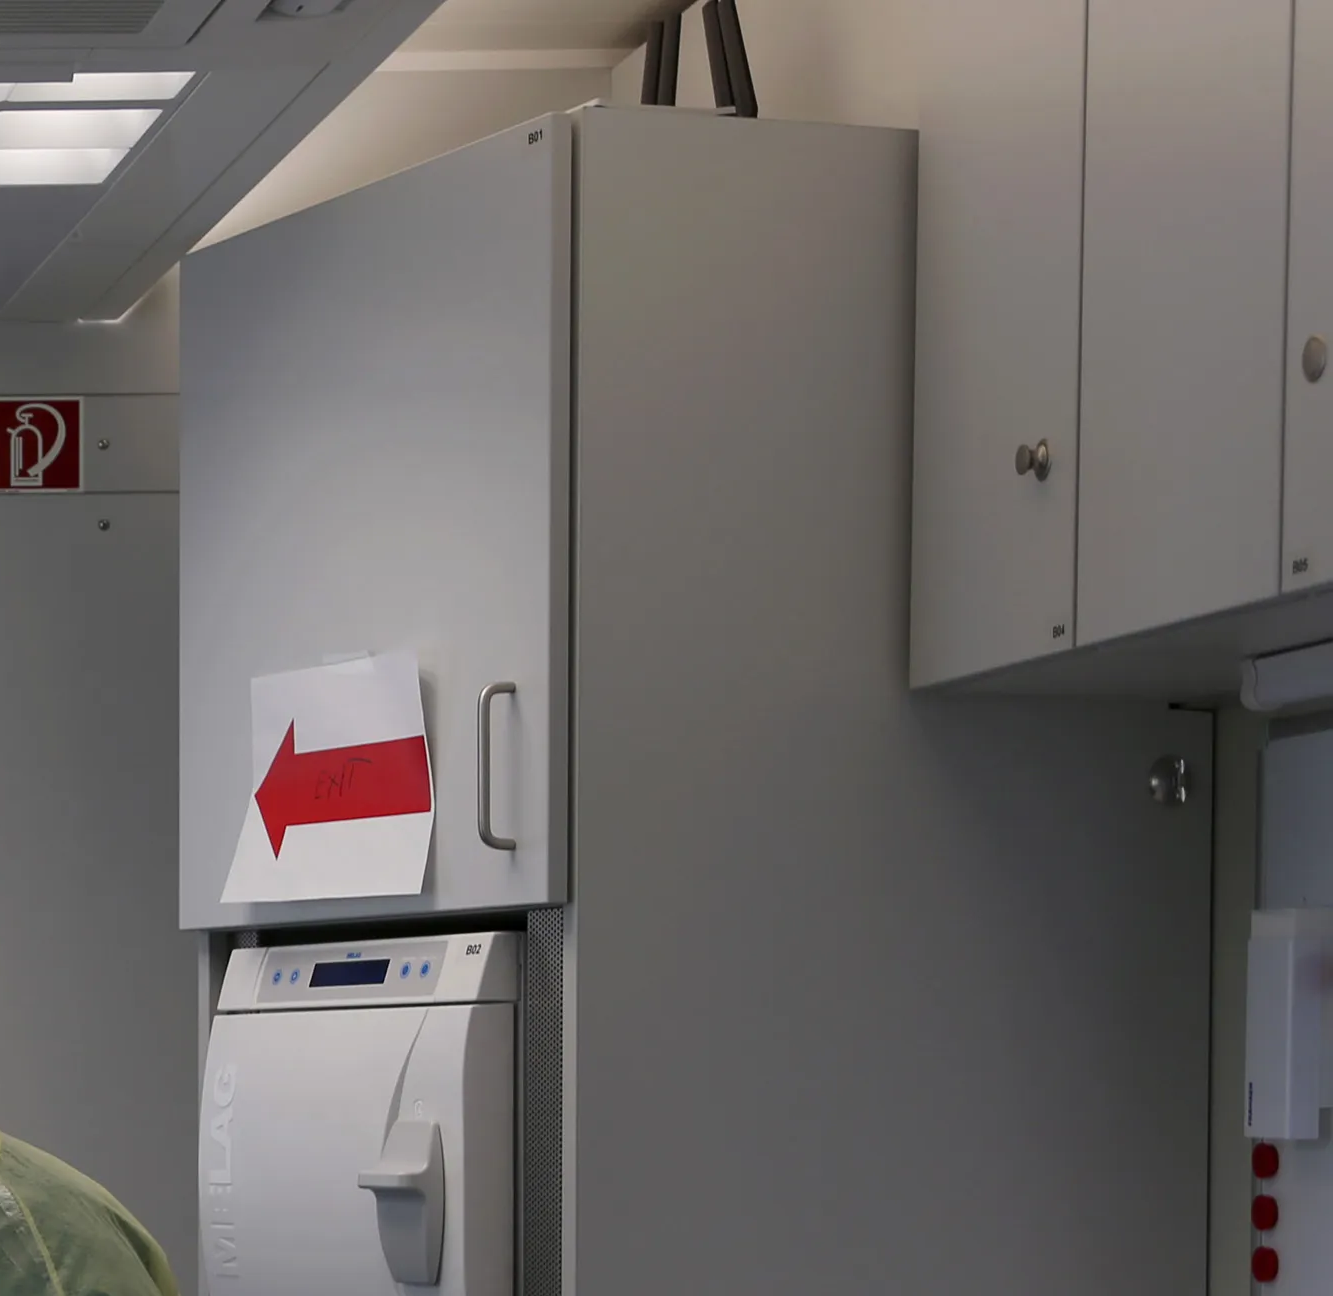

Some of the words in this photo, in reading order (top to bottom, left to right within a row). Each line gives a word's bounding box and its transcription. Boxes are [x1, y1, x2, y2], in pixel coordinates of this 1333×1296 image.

[528, 128, 543, 145] B01
[1052, 623, 1065, 639] B04
[313, 757, 373, 800] EXIT
[465, 943, 482, 956] B02
